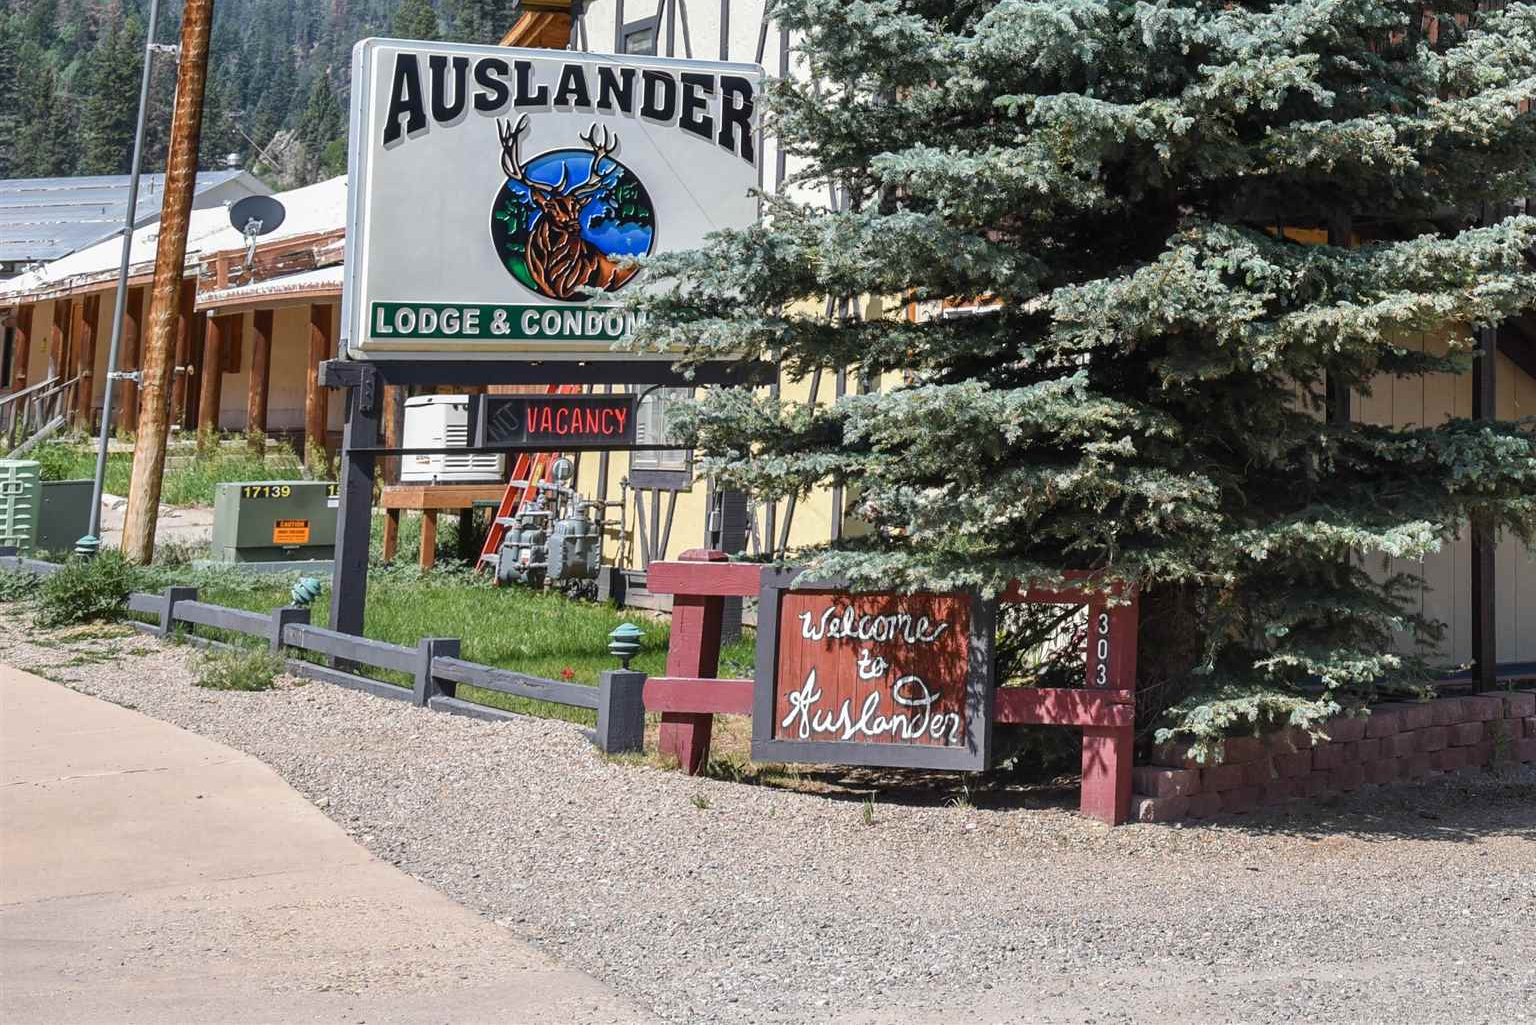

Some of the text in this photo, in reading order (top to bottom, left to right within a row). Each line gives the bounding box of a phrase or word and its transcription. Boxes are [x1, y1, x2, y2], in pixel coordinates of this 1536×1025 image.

[382, 52, 755, 165] AUSLANDER
[375, 306, 481, 335] LODGE
[489, 308, 511, 335] &
[526, 406, 628, 435] VACANCY
[244, 485, 292, 498] 17139
[798, 605, 949, 644] Welcome
[857, 648, 889, 680] to
[1096, 613, 1109, 685] 303
[781, 668, 961, 743] Auslander
